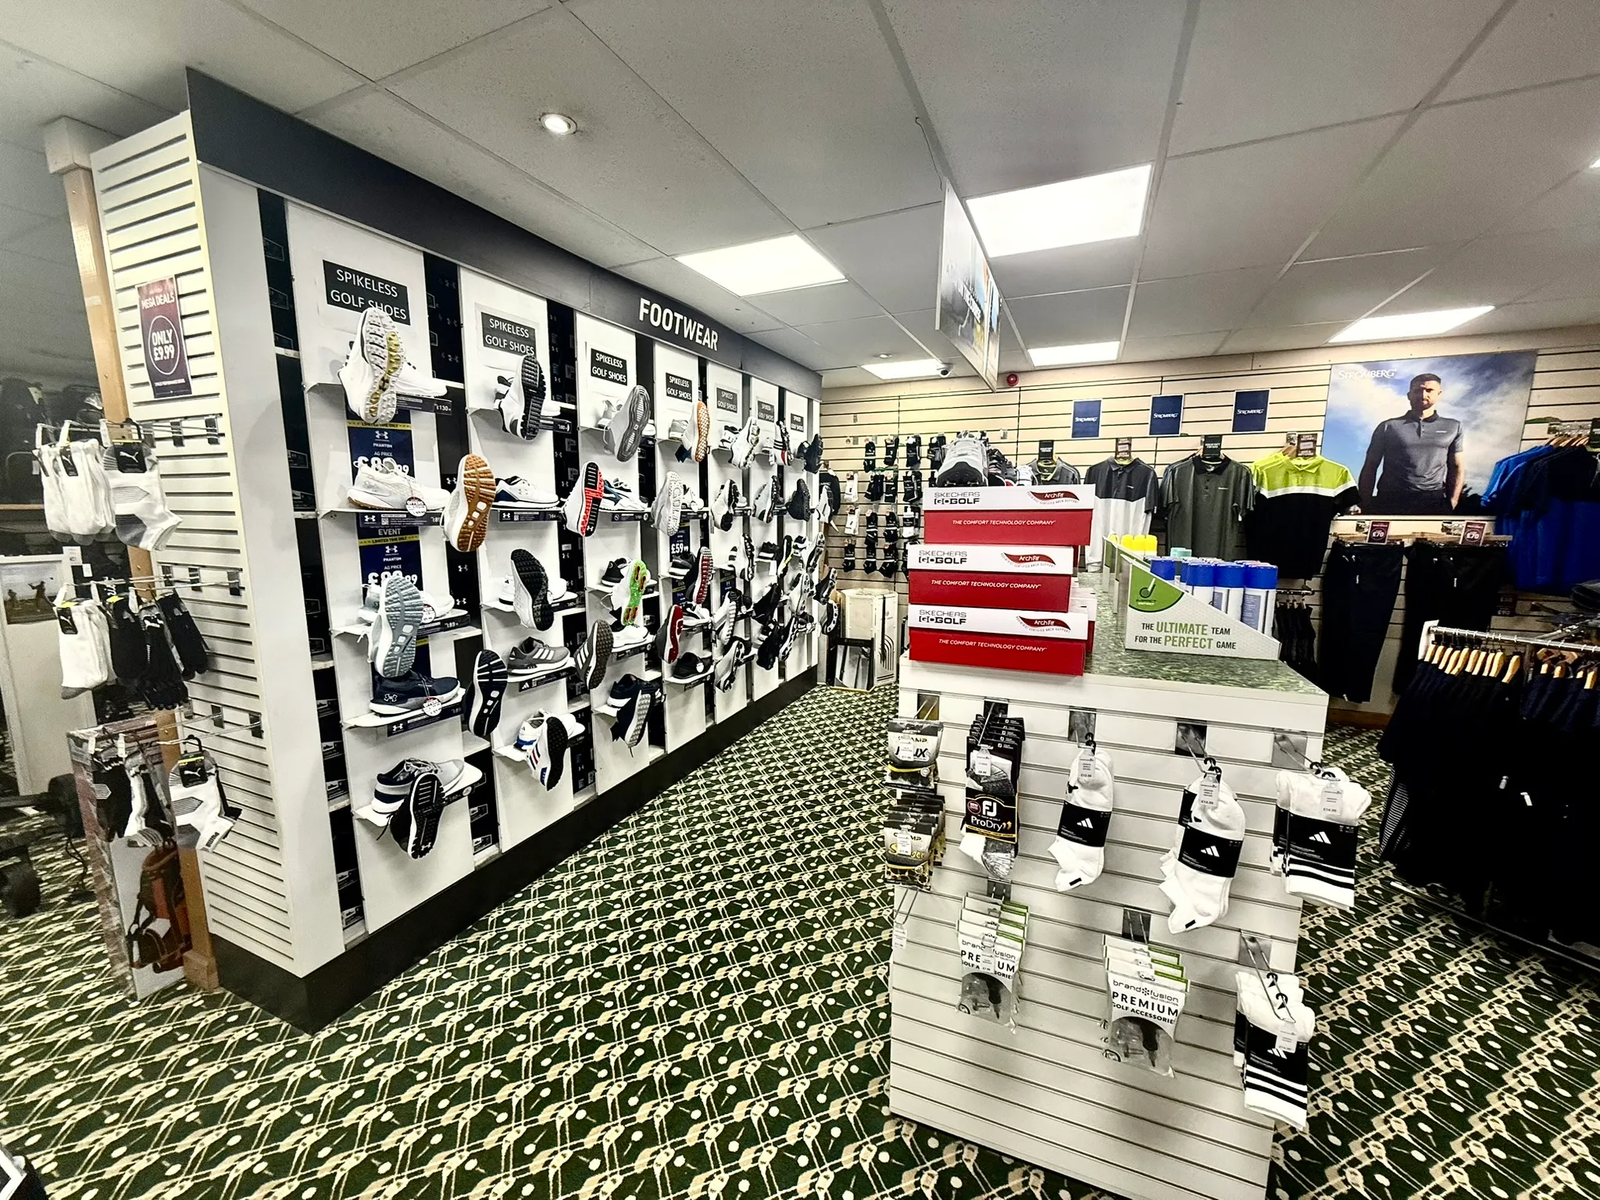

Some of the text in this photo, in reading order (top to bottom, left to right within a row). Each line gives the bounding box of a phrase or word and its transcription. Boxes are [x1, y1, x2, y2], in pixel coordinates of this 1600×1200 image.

[336, 269, 398, 298] SPIKELESS
[156, 292, 175, 305] DEALS
[330, 289, 407, 320] GOLF SHOES
[489, 318, 529, 338] SPIKELESS
[639, 297, 719, 352] FOOTWEAR
[152, 329, 173, 346] ONLY
[485, 334, 535, 356] GOLF SHOES
[153, 344, 175, 361] £9.99
[595, 352, 623, 369] SPIKELESS
[591, 366, 627, 383] GOLF SHOES
[378, 528, 401, 536] EVENT
[919, 609, 967, 618] SKECHERS
[1141, 621, 1231, 636] THE ULTIMATE TEAM
[949, 639, 977, 647] COMFORT
[977, 641, 1015, 650] TECHNOLOGY
[1134, 635, 1237, 650] FOR THE PERFECT GAME
[971, 815, 1003, 831] ProDry
[960, 949, 1015, 973] PREUM
[1113, 979, 1142, 993] brand
[1150, 990, 1179, 1003] fusion
[1112, 990, 1179, 1017] PREMIUM
[1130, 1008, 1175, 1025] ACCESSORIE
